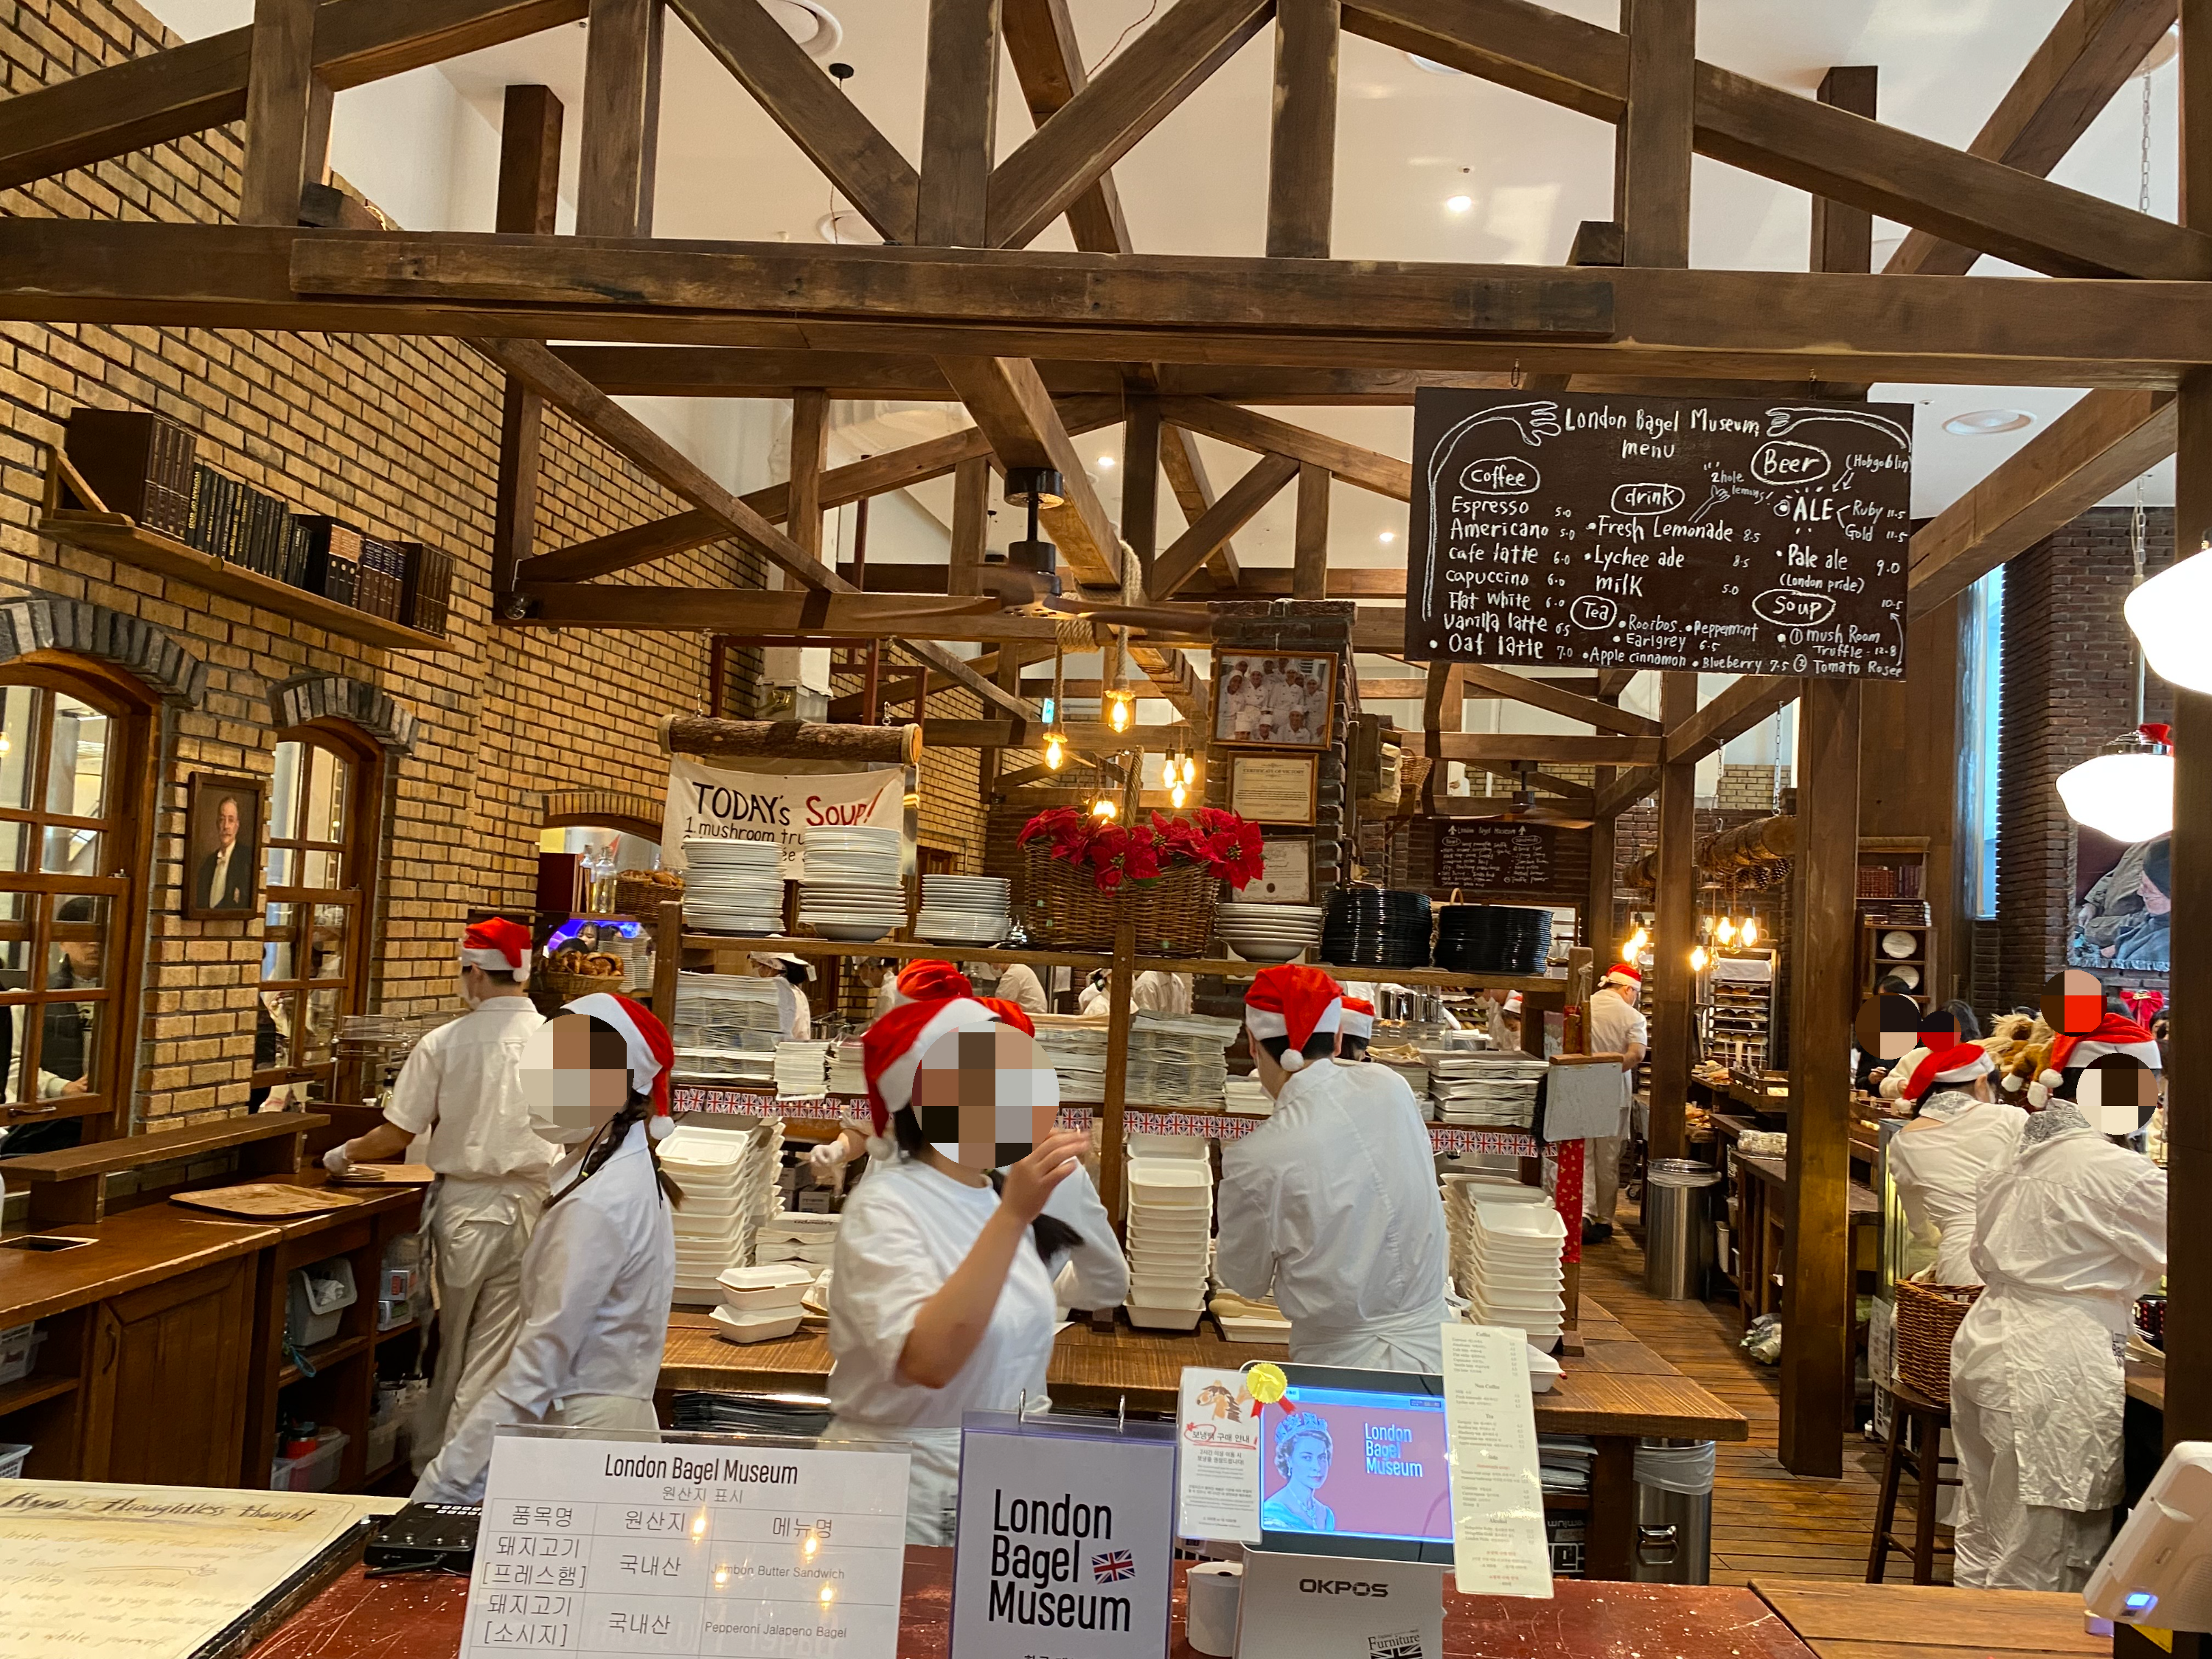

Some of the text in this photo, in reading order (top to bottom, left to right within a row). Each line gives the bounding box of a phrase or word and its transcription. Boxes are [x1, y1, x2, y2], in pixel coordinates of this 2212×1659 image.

[1565, 405, 1760, 439] London Bagel Museum
[1621, 439, 1675, 459] menu
[1764, 448, 1820, 476] Beer
[1452, 496, 1572, 520] Espresso 5.0
[1792, 496, 1834, 522] ALE
[1852, 499, 1884, 524] Ruby
[1450, 518, 1576, 540] Americano 5.0
[1598, 515, 1761, 543] Fresh Lemonade 8.5
[1845, 524, 1874, 542] Gold
[1493, 542, 1539, 564] latte
[1553, 551, 1571, 565] 6.0
[1594, 544, 1750, 571] Lychee ade 8.5
[1788, 543, 1901, 576] Pale ale 9.0
[1548, 573, 1565, 586] 6.0
[1722, 584, 1739, 595] 5.0
[1545, 597, 1565, 608] 6.0
[1582, 601, 1610, 621] Tea
[1508, 612, 1548, 634] latte
[1555, 623, 1571, 637] 6.5
[1628, 613, 1677, 632] Rooibos
[1848, 625, 1881, 643] Room
[1448, 633, 1573, 660] Oat latte 7.0
[1589, 647, 1686, 667] Apple cinnamon
[1699, 640, 1721, 652] 6.5
[1812, 644, 1863, 658] Truffle
[1702, 655, 1790, 675] Blueberry 7.5
[1812, 659, 1860, 675] Tomato
[699, 822, 775, 843] mushroom
[781, 829, 804, 846] tru
[1365, 1422, 1412, 1443] London
[1366, 1439, 1401, 1461] Bagel
[605, 1453, 798, 1484] London Bagel Museum
[1366, 1456, 1423, 1478] Museum
[662, 1486, 744, 1504] 원산지 표시
[512, 1505, 833, 1540] 품목명 원산지 메뉴명
[994, 1489, 1112, 1540] London
[496, 1536, 580, 1559] 돼지고기
[482, 1554, 682, 1588] [프레스햄] 국내산
[757, 1565, 790, 1577] Butter
[793, 1567, 845, 1579] Sandwich
[991, 1534, 1080, 1589] Bagel
[1299, 1579, 1389, 1598] OKPOS
[487, 1593, 572, 1617] 돼지고기
[988, 1579, 1131, 1632] Museum
[484, 1612, 672, 1647] [소시지] 국내산
[705, 1621, 848, 1639] Pepperoni Jalapeno Bagel
[1368, 1634, 1421, 1651] Furniture
